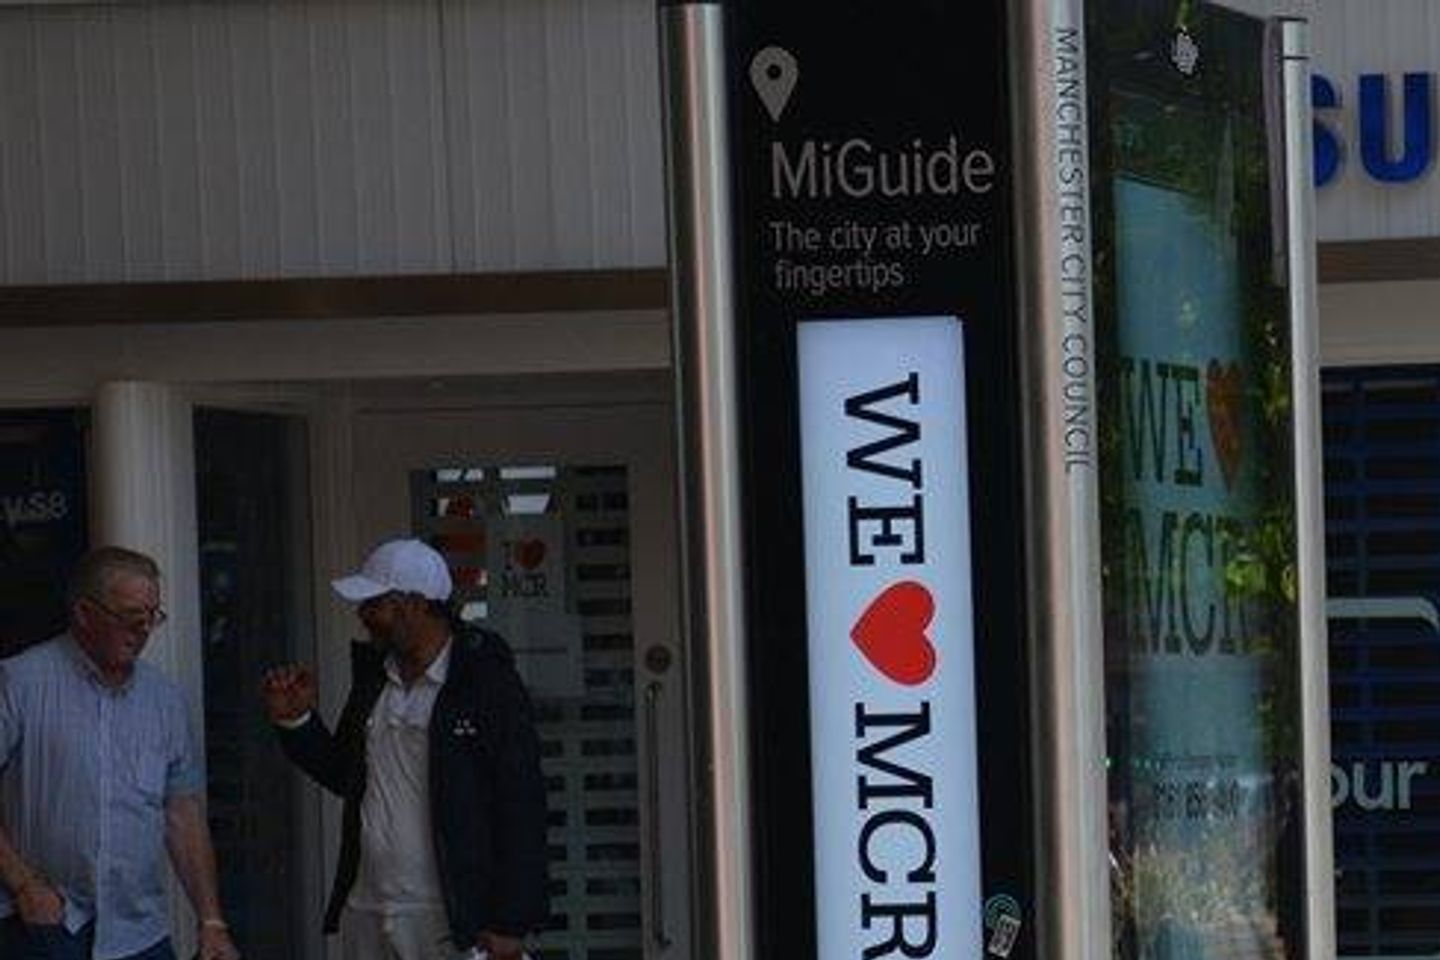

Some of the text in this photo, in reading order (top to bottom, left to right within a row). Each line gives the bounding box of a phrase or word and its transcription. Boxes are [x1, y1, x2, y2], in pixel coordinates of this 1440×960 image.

[770, 136, 995, 199] MiGuide
[769, 221, 981, 256] The city at your
[774, 259, 905, 296] fingertips
[1055, 27, 1094, 475] MANCHESTER CITY COUNCIL
[843, 371, 926, 566] WE
[1117, 356, 1204, 488] WE
